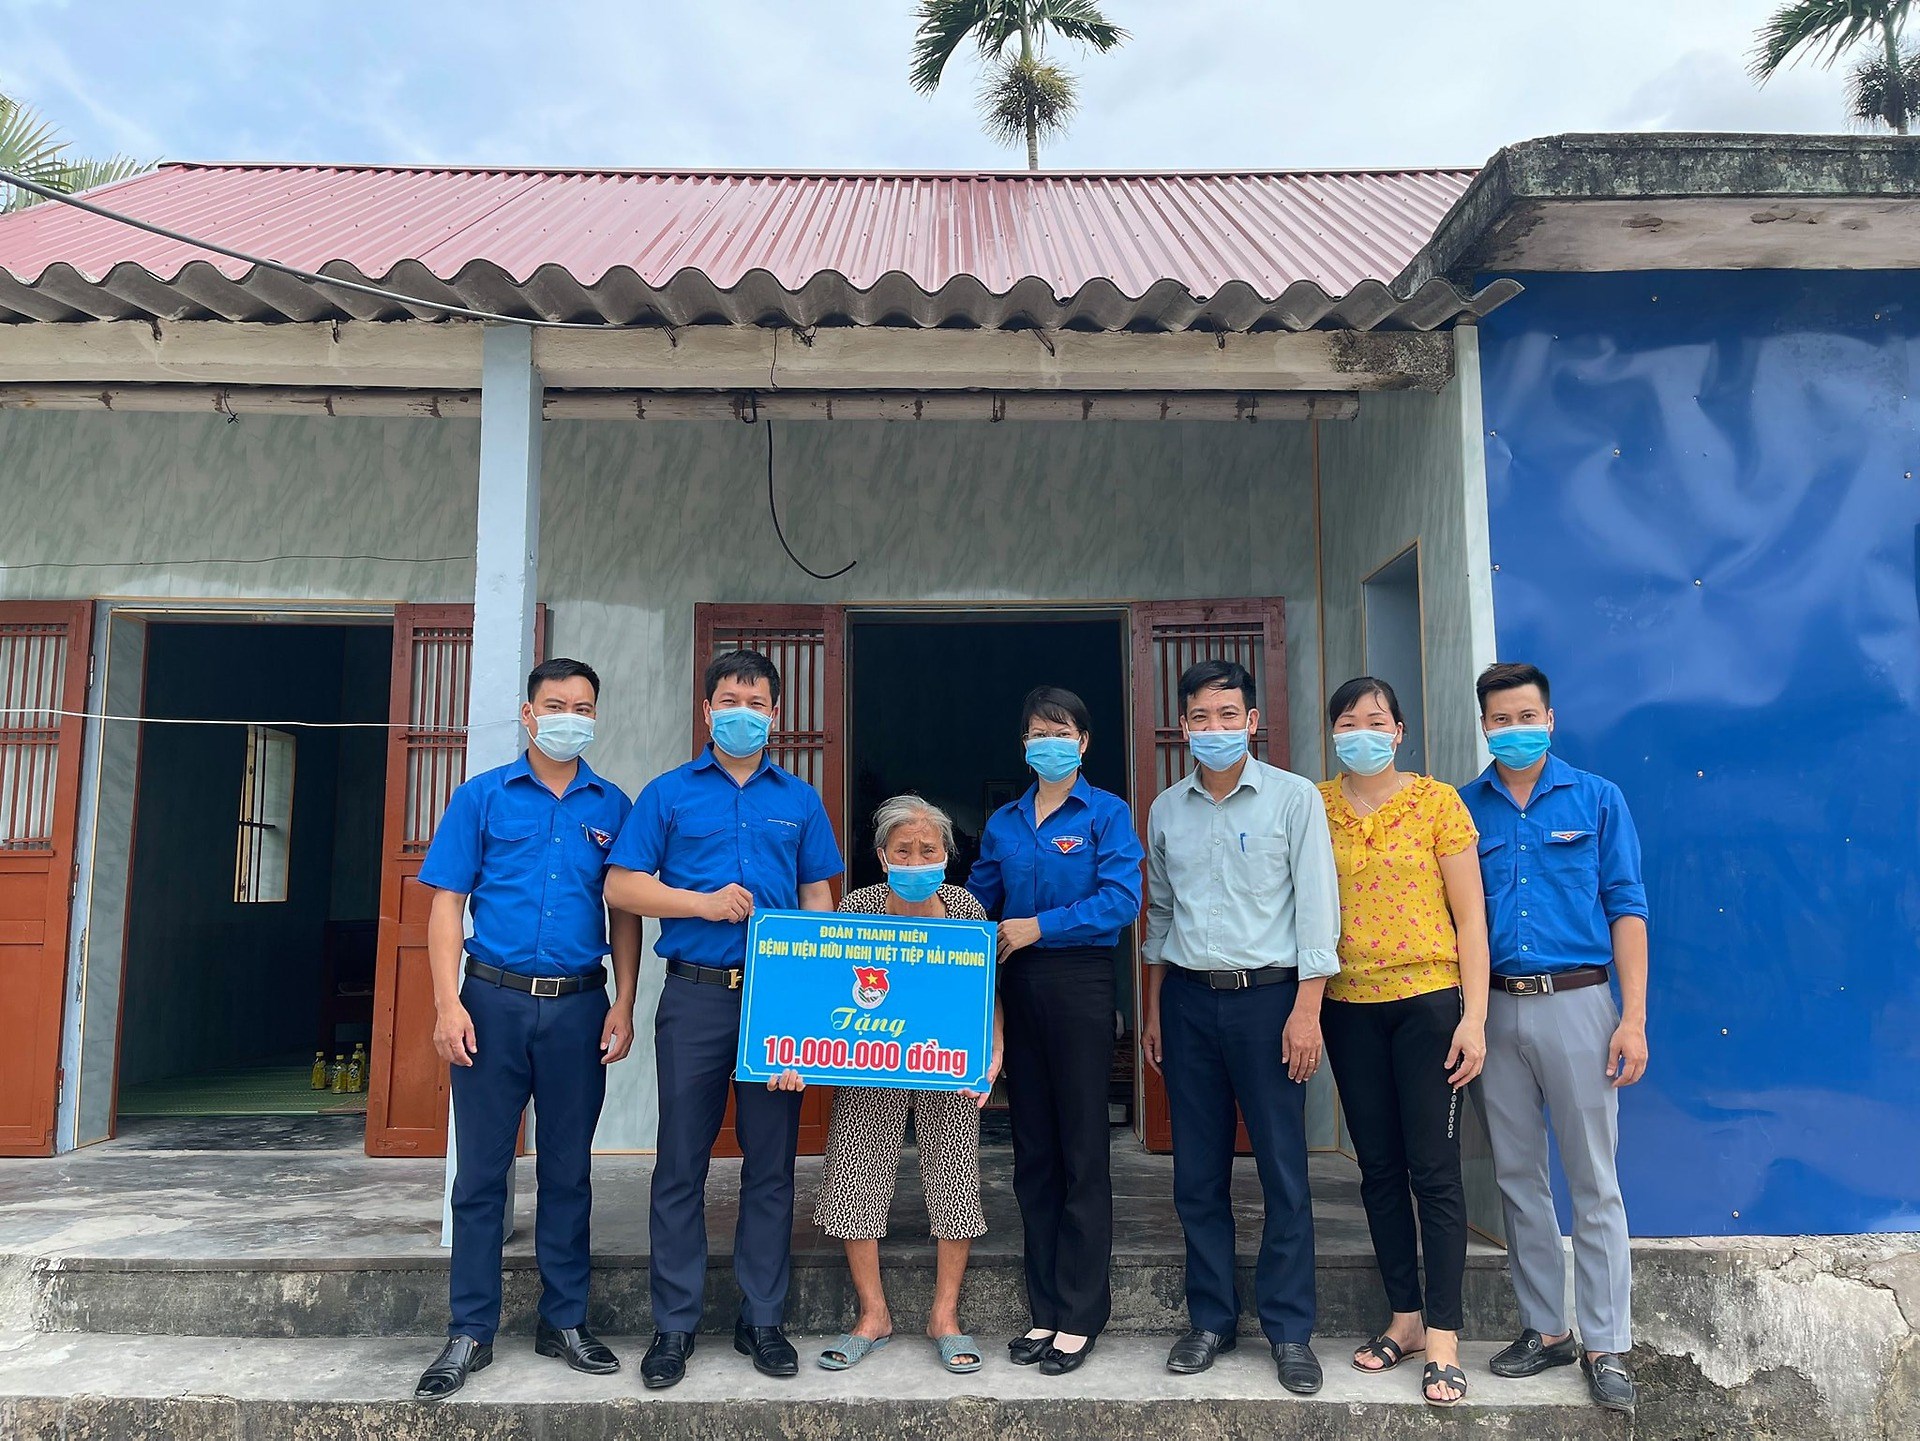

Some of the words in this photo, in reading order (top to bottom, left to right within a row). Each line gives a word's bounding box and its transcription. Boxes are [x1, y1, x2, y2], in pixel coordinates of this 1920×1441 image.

[820, 925, 853, 940] ĐOÀN
[856, 927, 896, 942] THANH
[899, 929, 928, 944] NIÊN
[758, 938, 789, 958] BỆNH
[792, 939, 817, 960] VIỆN
[820, 941, 843, 959] HỮU
[845, 944, 872, 963] NGHỊ
[875, 944, 898, 965] VIỆT
[900, 945, 924, 966] TIỆP
[926, 945, 945, 965] HẢI
[948, 948, 985, 967] PHÒNG
[830, 1006, 906, 1038] Tặng
[764, 1035, 901, 1070] 10.000.000
[906, 1038, 968, 1077] đồng
